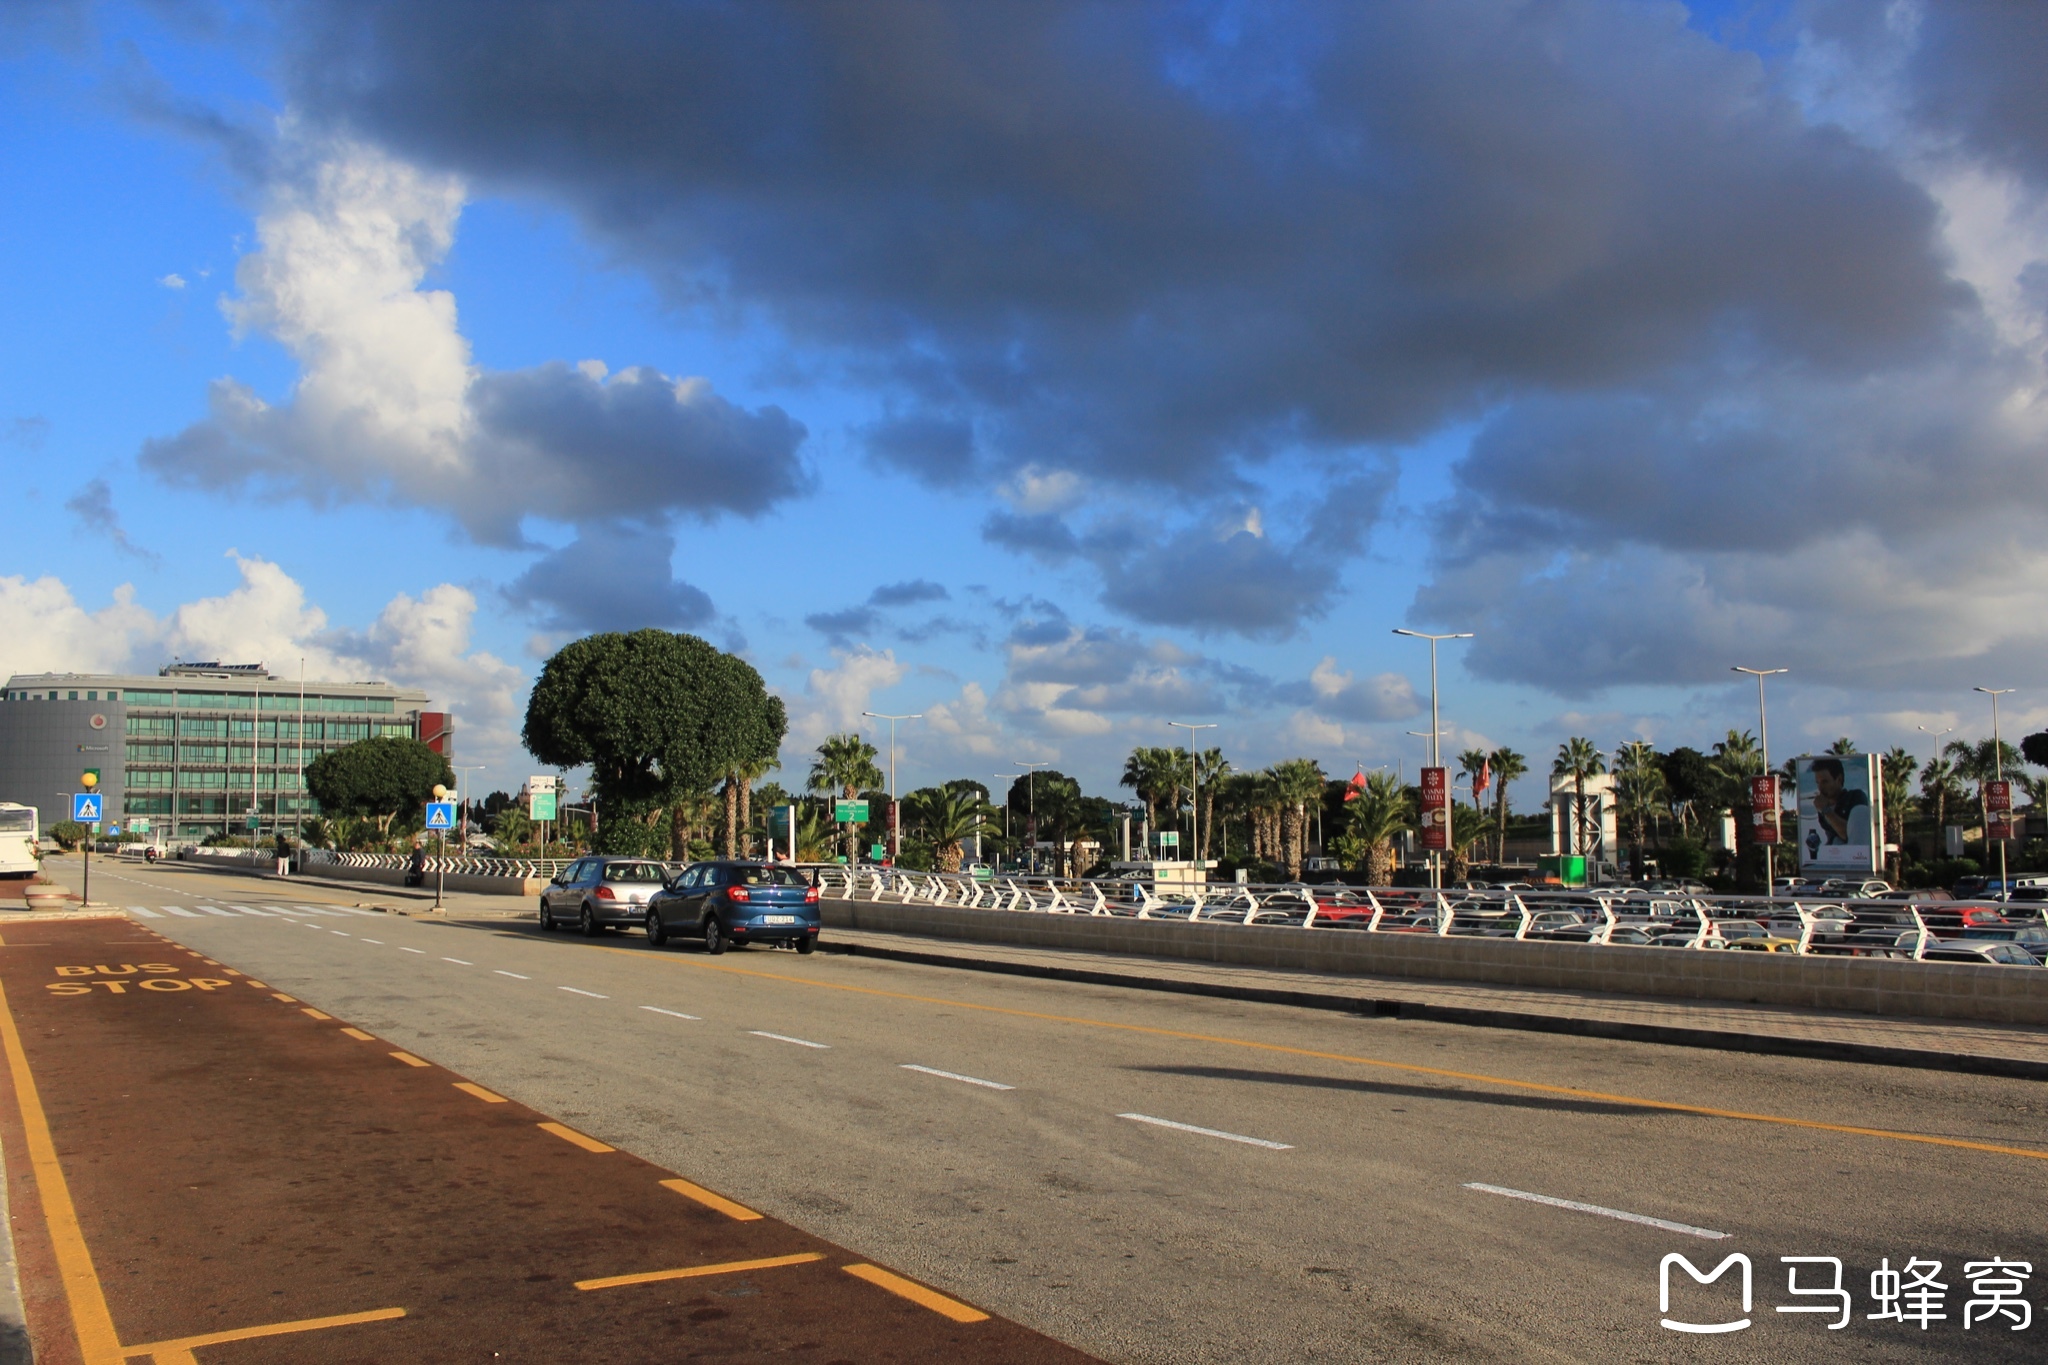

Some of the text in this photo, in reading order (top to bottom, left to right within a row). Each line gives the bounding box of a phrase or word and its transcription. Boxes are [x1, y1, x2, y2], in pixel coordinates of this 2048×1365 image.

[849, 812, 854, 820] 2
[55, 963, 180, 976] BUS
[45, 978, 232, 996] STOP
